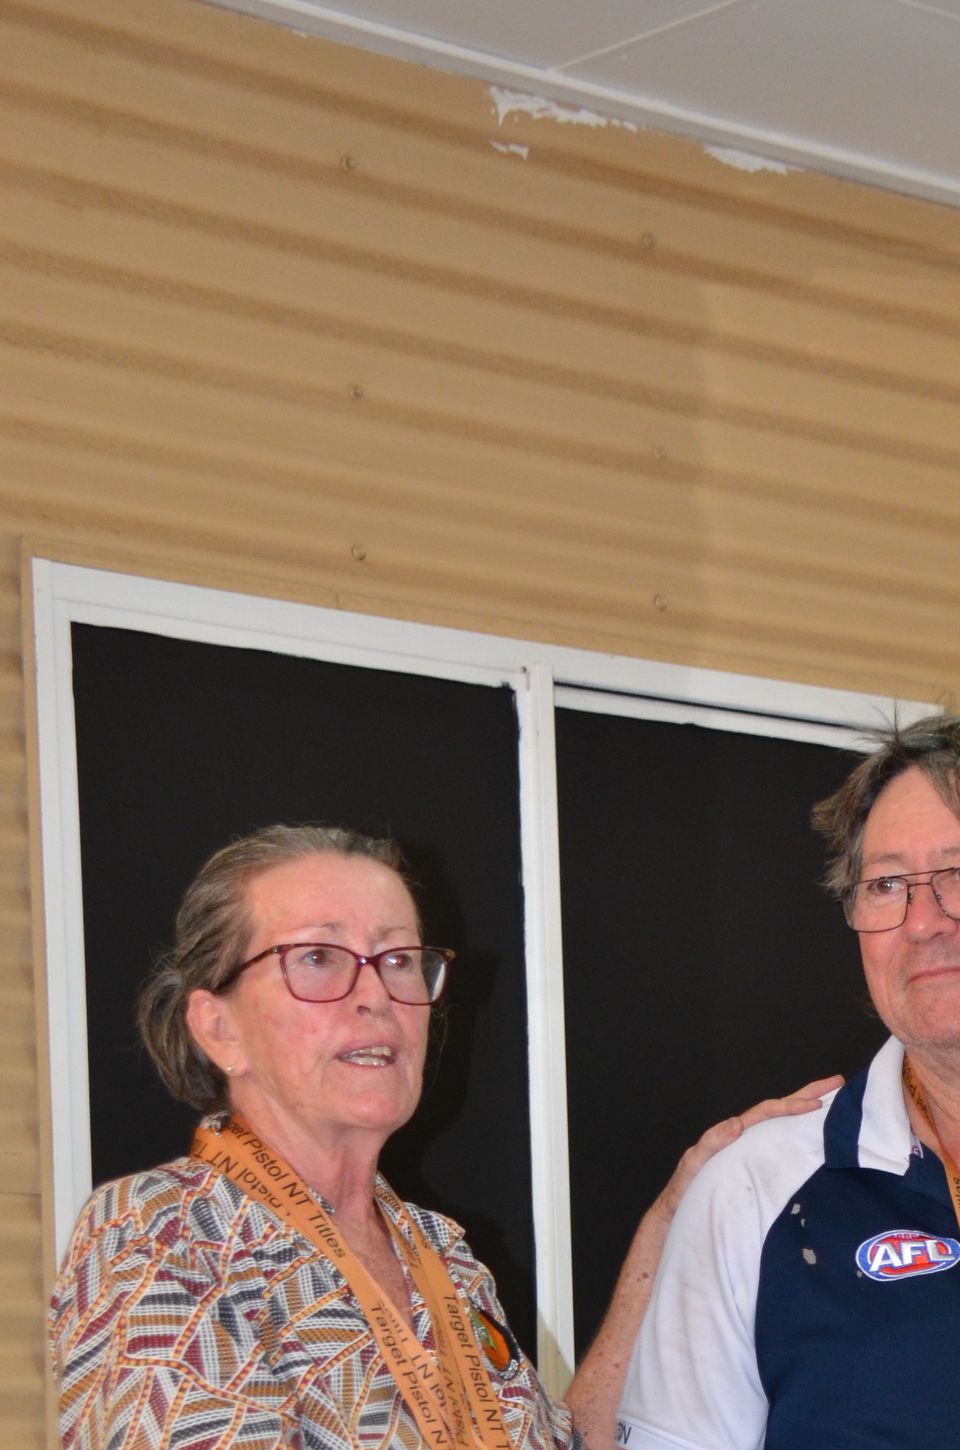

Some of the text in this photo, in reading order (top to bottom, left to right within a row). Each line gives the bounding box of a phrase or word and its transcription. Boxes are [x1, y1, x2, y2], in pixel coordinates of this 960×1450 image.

[242, 1137, 347, 1259] Pistol NT Titles
[869, 1240, 956, 1272] AFL
[370, 1302, 408, 1366] Target
[402, 1370, 438, 1424] Pistol
[443, 1295, 474, 1350] Target
[465, 1354, 492, 1405] Pistol
[484, 1408, 505, 1433] NT
